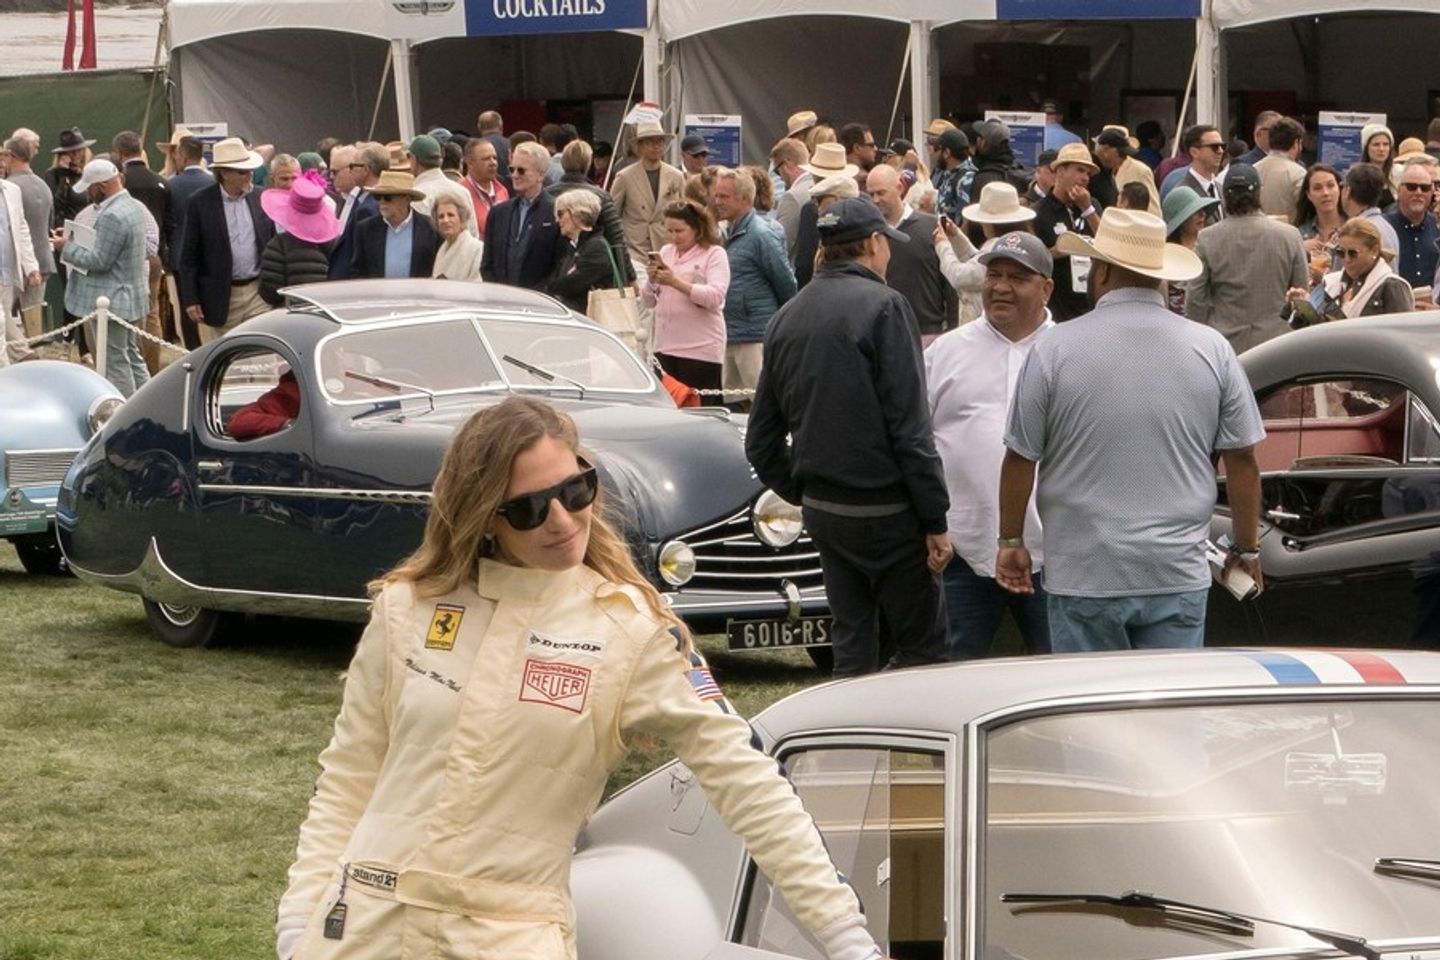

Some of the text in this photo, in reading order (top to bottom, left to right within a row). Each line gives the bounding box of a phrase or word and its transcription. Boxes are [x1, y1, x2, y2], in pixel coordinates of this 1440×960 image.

[744, 619, 827, 648] 6016-RS
[541, 639, 601, 652] DUNLOP
[530, 663, 587, 677] CHRONOGRAPH
[531, 673, 580, 697] HEUER
[353, 868, 397, 887] stand 21
